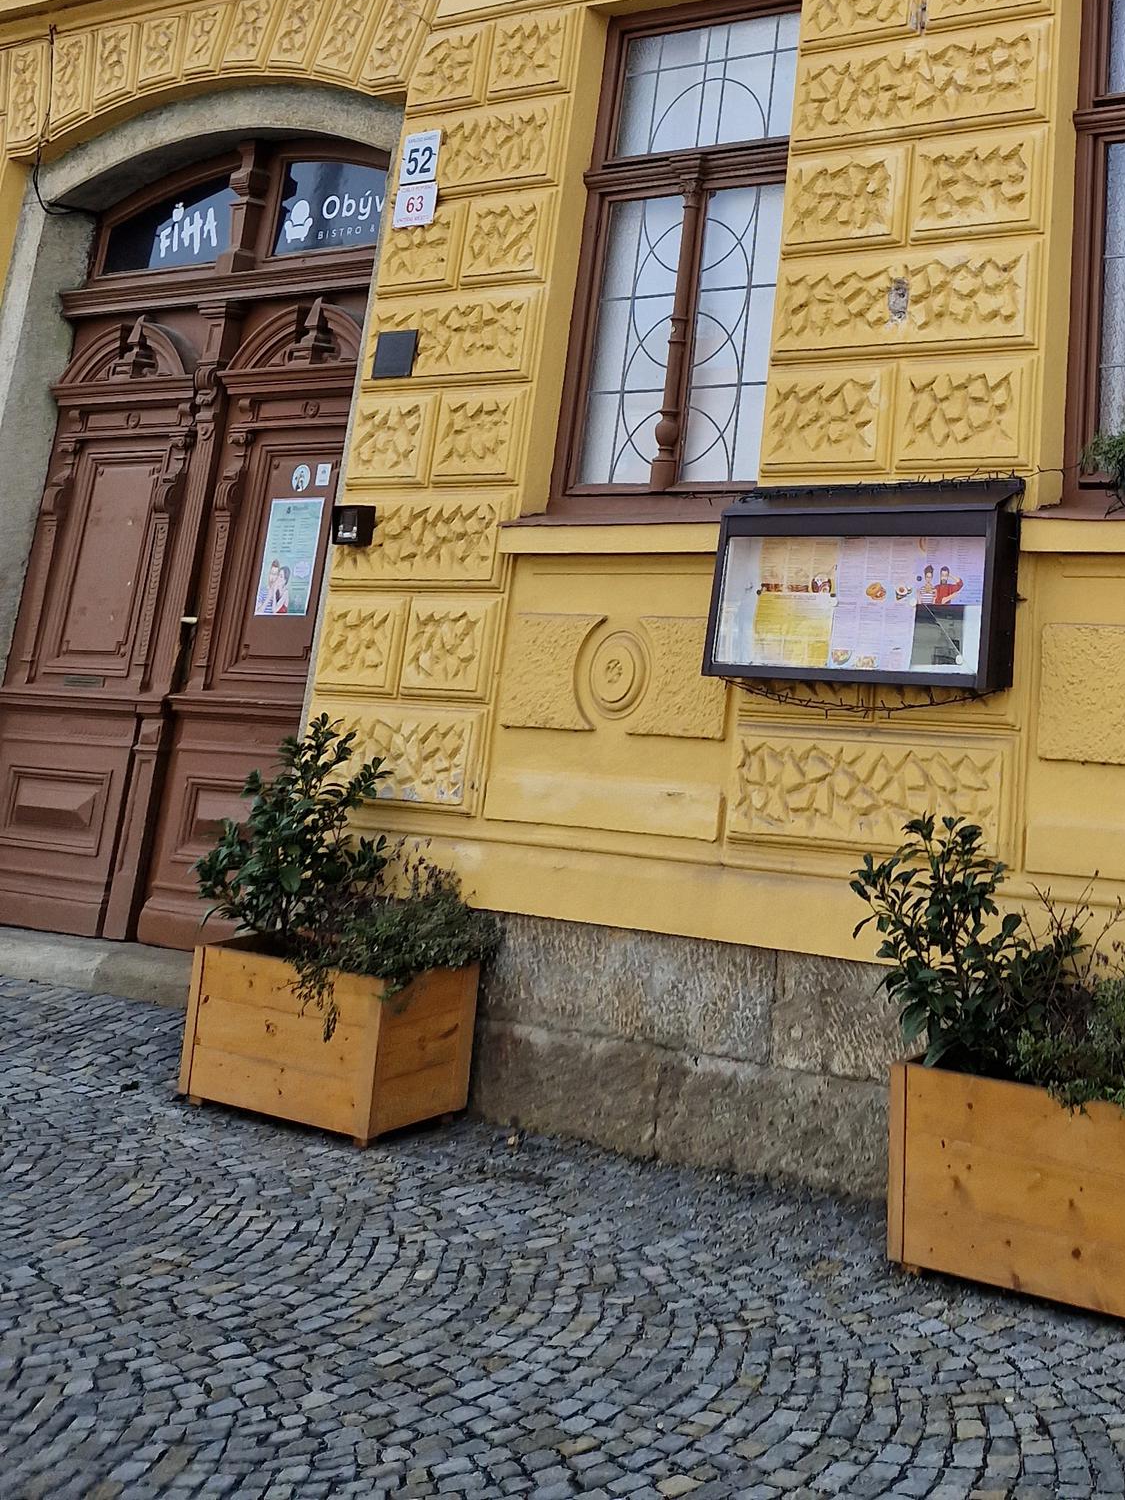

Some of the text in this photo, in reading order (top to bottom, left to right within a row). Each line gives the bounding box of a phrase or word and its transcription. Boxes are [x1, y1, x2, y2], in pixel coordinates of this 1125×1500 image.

[405, 146, 433, 176] 52
[406, 195, 424, 214] 63
[317, 226, 362, 240] BISTRO
